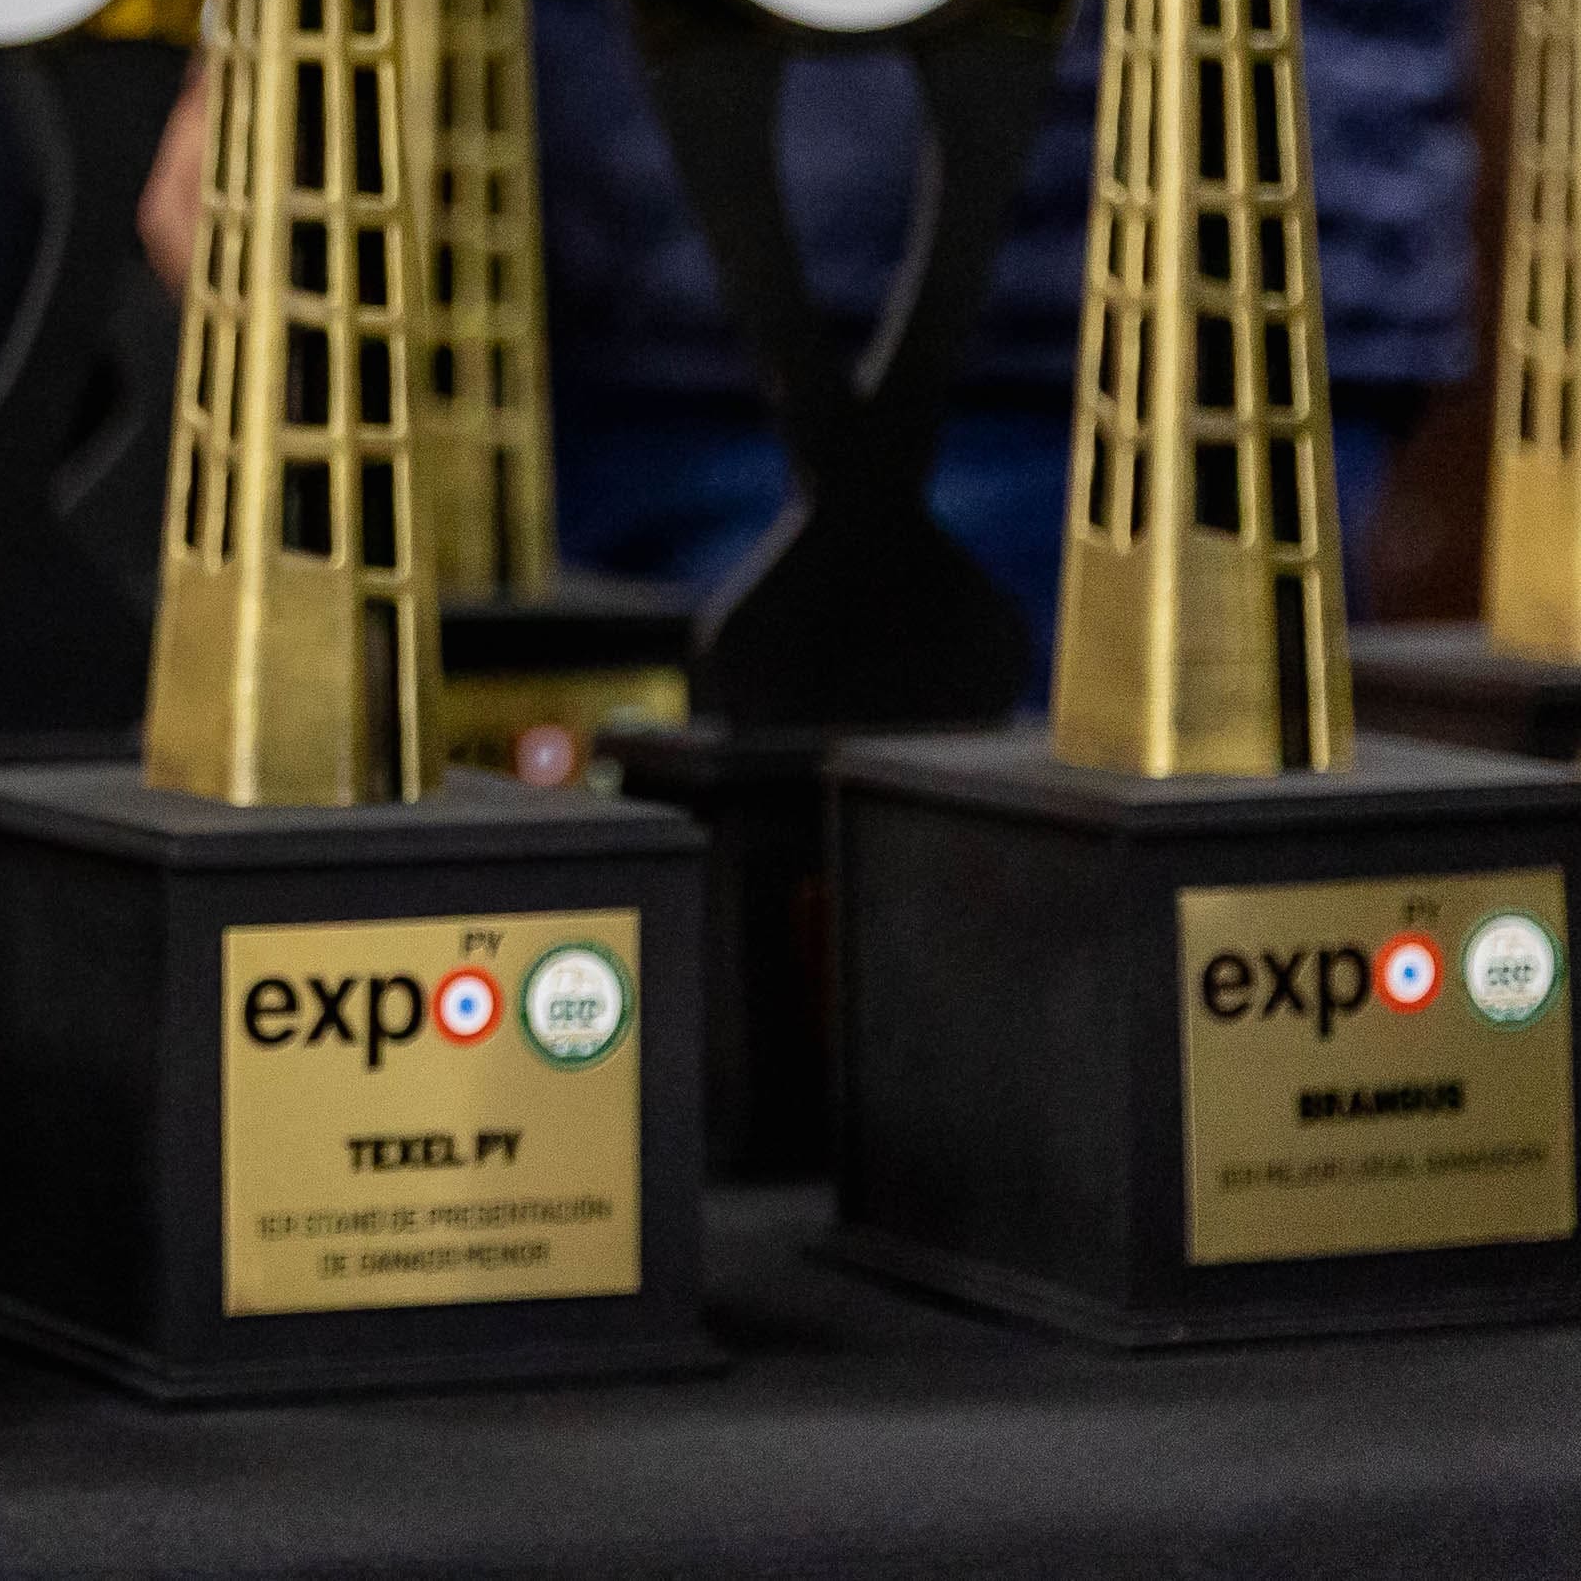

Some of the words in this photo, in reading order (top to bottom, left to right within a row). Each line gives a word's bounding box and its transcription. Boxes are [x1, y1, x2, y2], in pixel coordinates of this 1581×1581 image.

[461, 931, 504, 957] PY
[348, 1133, 463, 1172] TEXEL
[473, 1129, 522, 1164] PY
